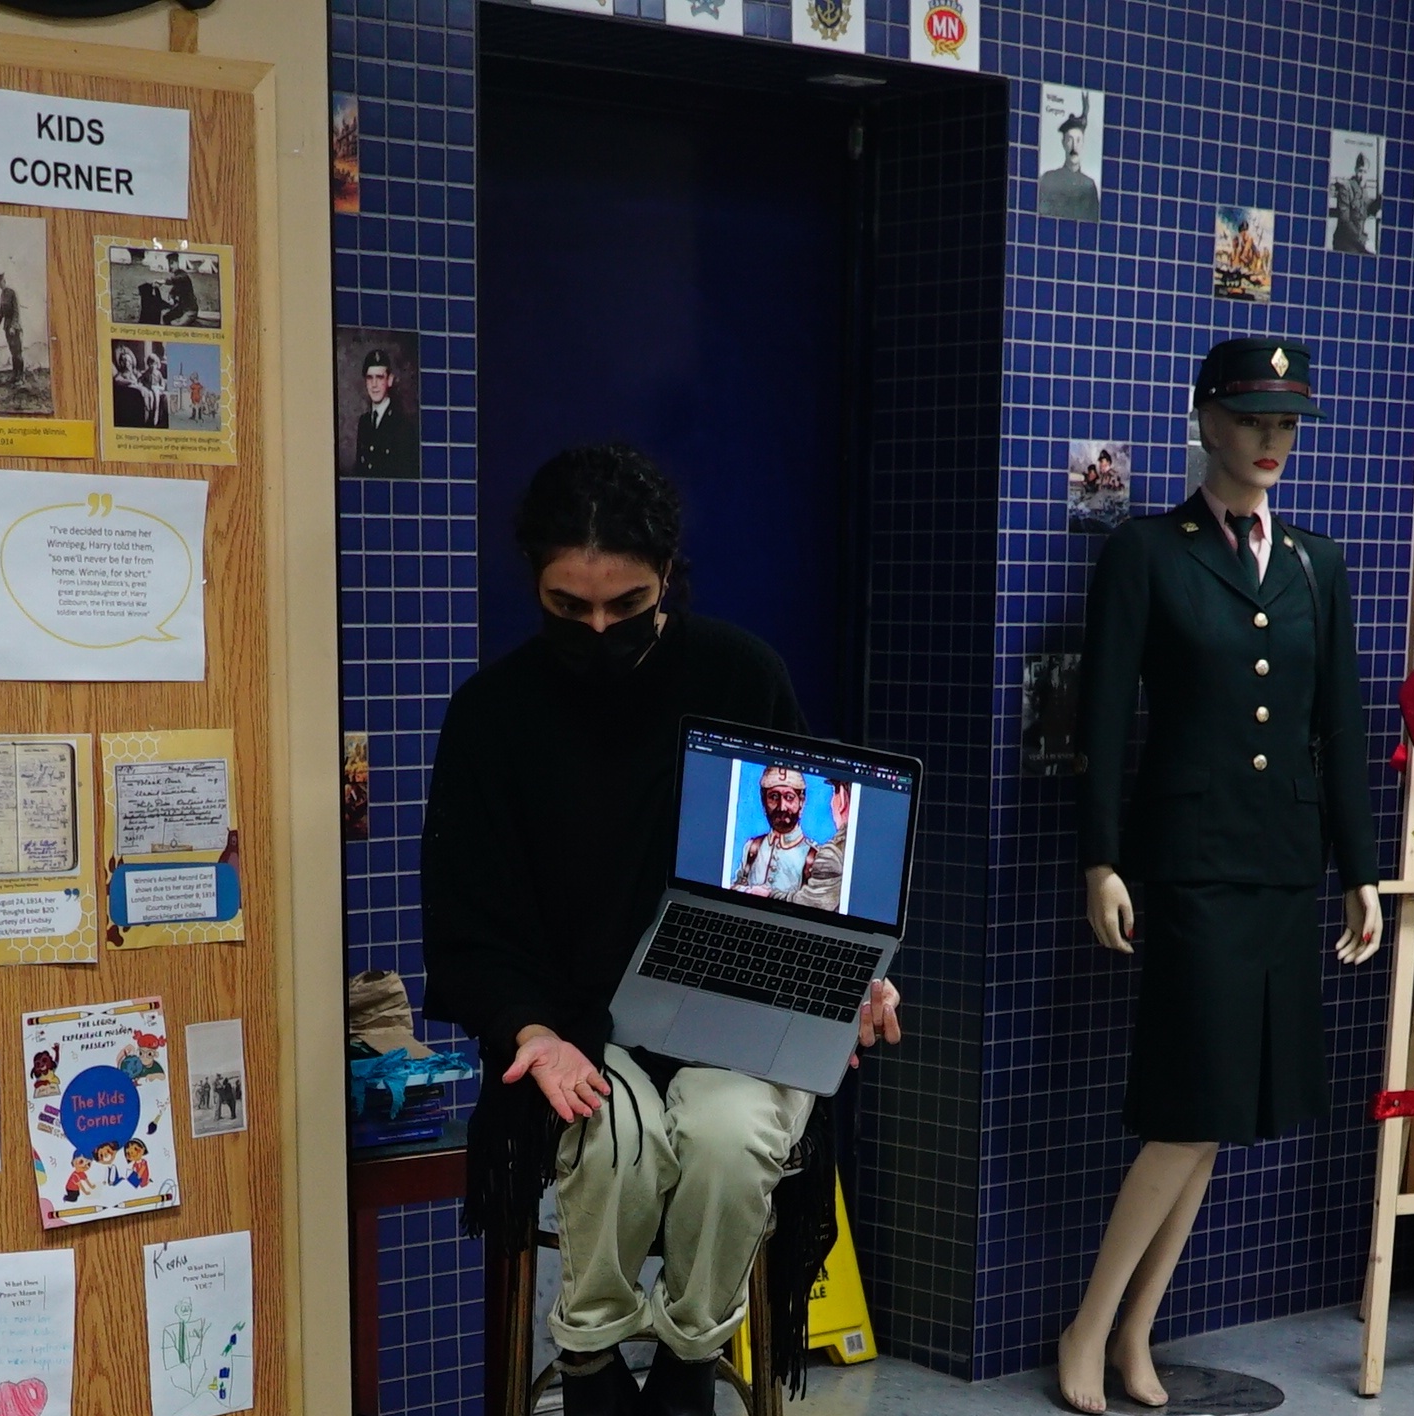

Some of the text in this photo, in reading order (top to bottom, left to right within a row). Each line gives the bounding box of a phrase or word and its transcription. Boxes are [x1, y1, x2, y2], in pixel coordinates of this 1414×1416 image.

[932, 14, 959, 40] MN
[37, 112, 104, 145] KIDS
[10, 157, 134, 195] CORNER
[69, 526, 102, 536] decided
[104, 528, 113, 536] to
[138, 529, 151, 538] her
[89, 541, 111, 551] Harry
[113, 541, 130, 550] told
[132, 543, 155, 552] them,
[109, 555, 119, 564] be
[121, 555, 132, 564] far
[134, 556, 154, 565] from
[111, 569, 122, 577] for
[77, 1018, 117, 1028] THE LEGION
[62, 1027, 133, 1042] EXPERIENCE MUSEUM
[71, 1090, 125, 1112] The Kids
[76, 1113, 123, 1131] Corner
